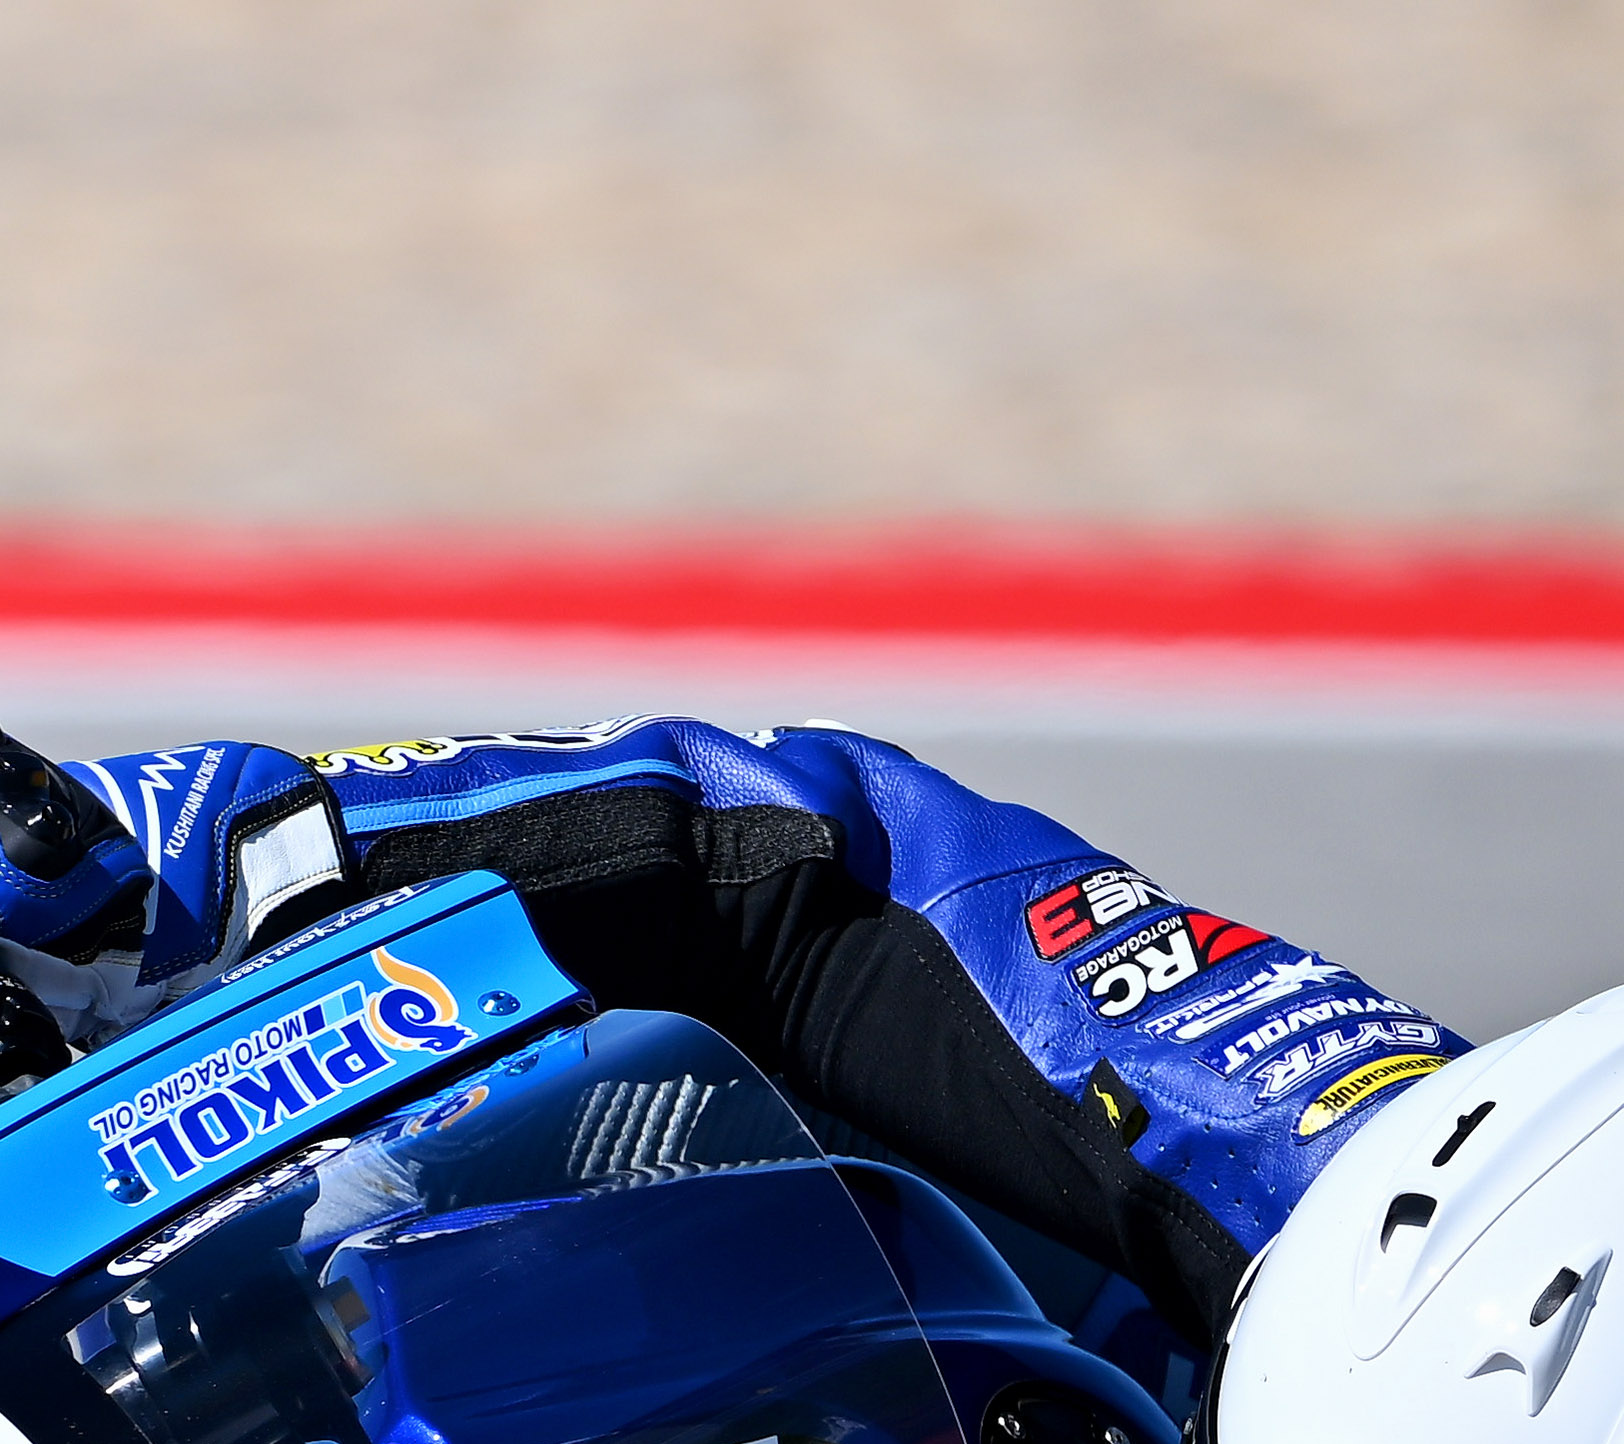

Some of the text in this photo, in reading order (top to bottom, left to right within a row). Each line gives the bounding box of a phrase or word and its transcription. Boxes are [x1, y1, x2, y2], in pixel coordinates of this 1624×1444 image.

[1076, 914, 1183, 983] MOTOGARAGE
[1092, 930, 1198, 1018] RC
[1222, 996, 1422, 1074] DYNAVOLT
[1258, 1024, 1440, 1100] GYTR
[90, 1014, 307, 1142] MOTO RACING OIL
[99, 1014, 396, 1197] PIKOLI
